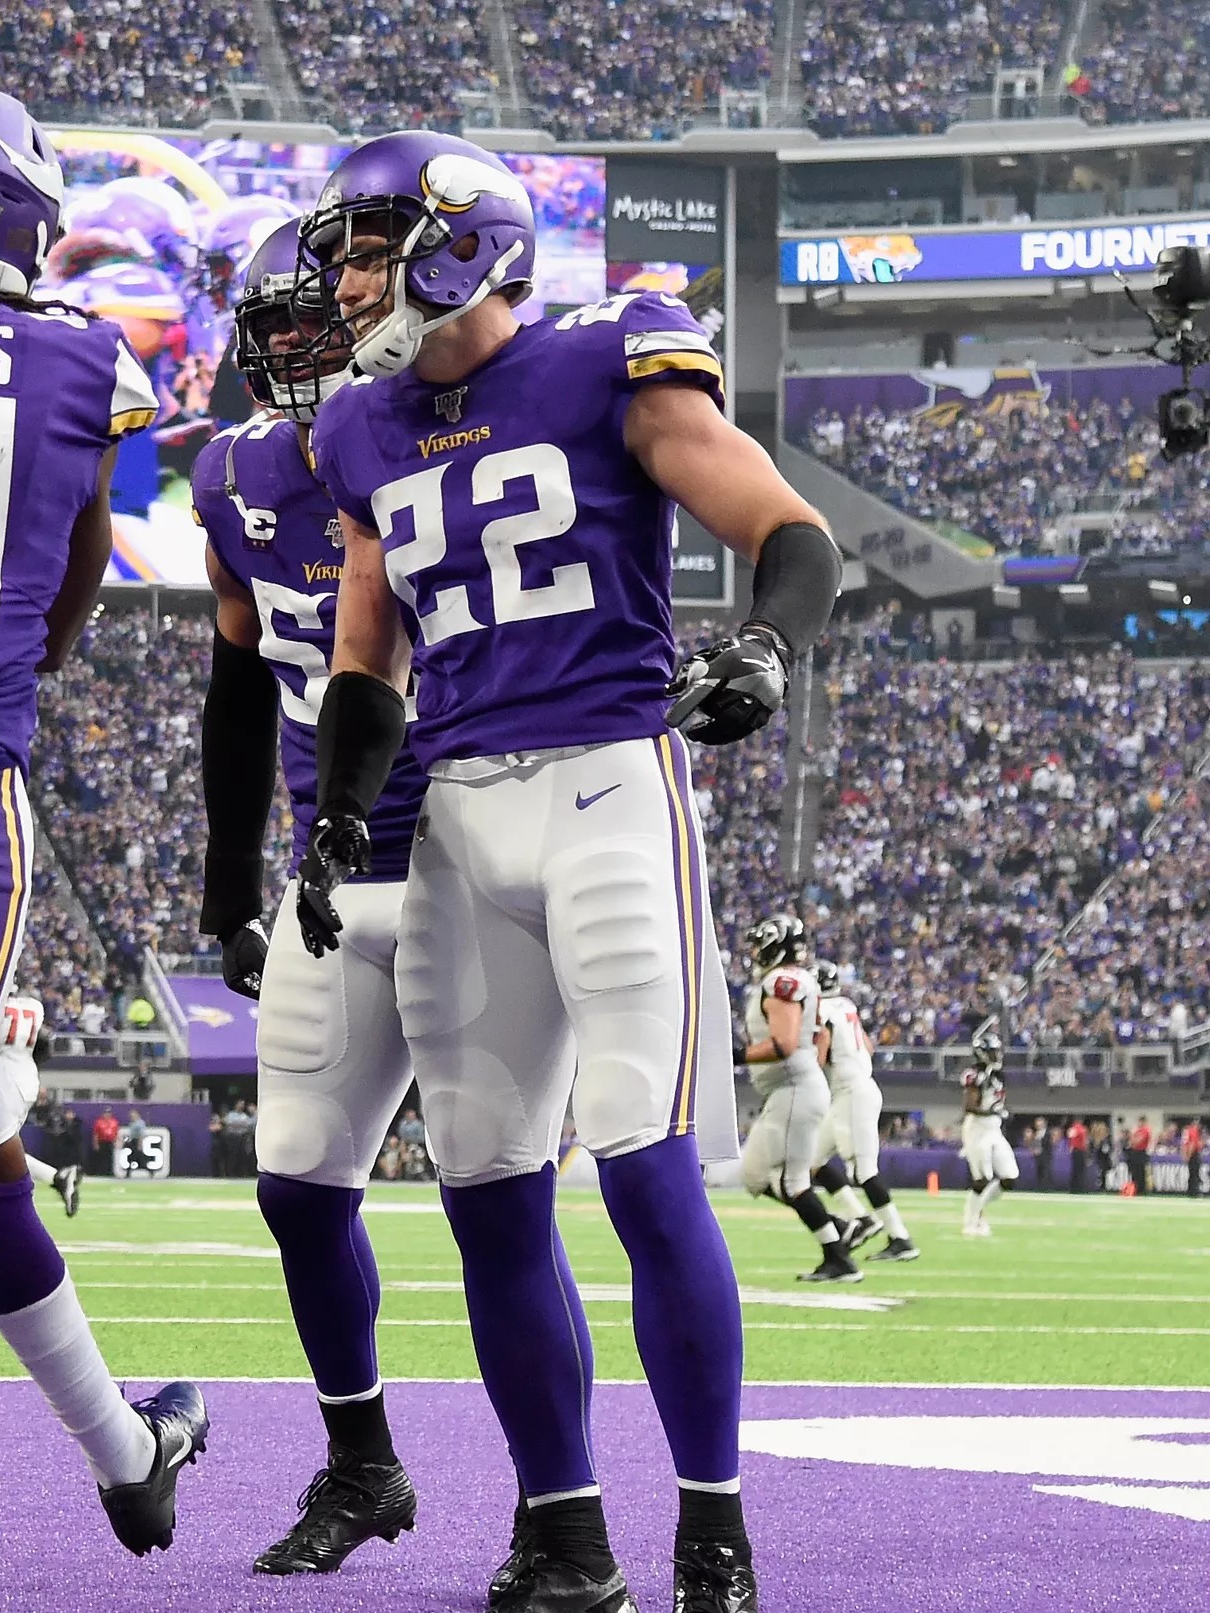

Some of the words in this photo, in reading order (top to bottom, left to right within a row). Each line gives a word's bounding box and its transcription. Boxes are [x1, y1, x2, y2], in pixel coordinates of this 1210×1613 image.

[244, 508, 278, 541] C
[370, 442, 596, 647] 22
[4, 1006, 36, 1048] 77
